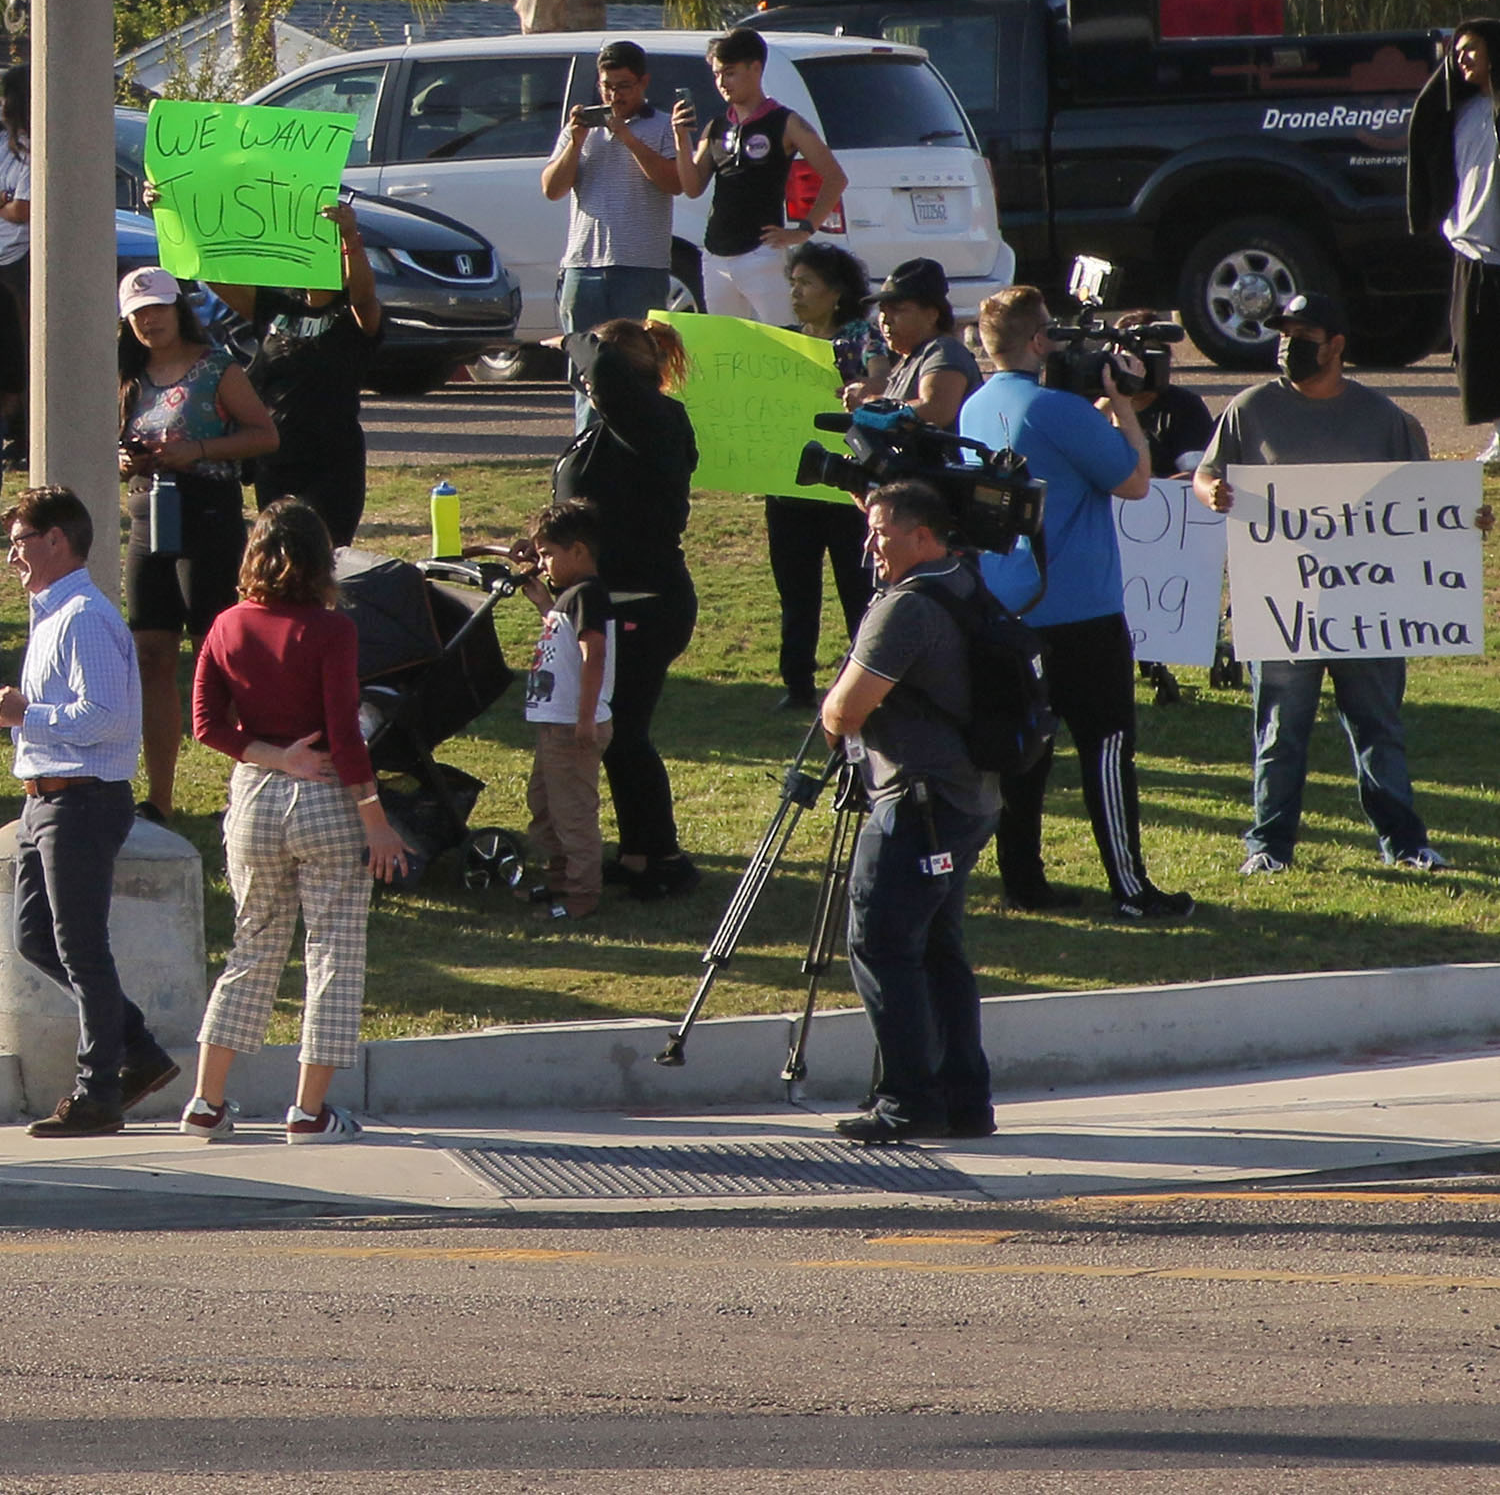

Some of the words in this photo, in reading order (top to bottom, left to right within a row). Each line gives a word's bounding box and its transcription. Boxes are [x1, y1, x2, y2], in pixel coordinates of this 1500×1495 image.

[156, 114, 221, 157] WE
[240, 118, 354, 152] WANT
[1262, 106, 1412, 130] DroneRanger
[1350, 156, 1409, 166] #dronerange
[1249, 482, 1470, 543] Justicia
[1298, 553, 1396, 589] Para
[1423, 560, 1467, 589] la
[1264, 595, 1473, 653] Victima
